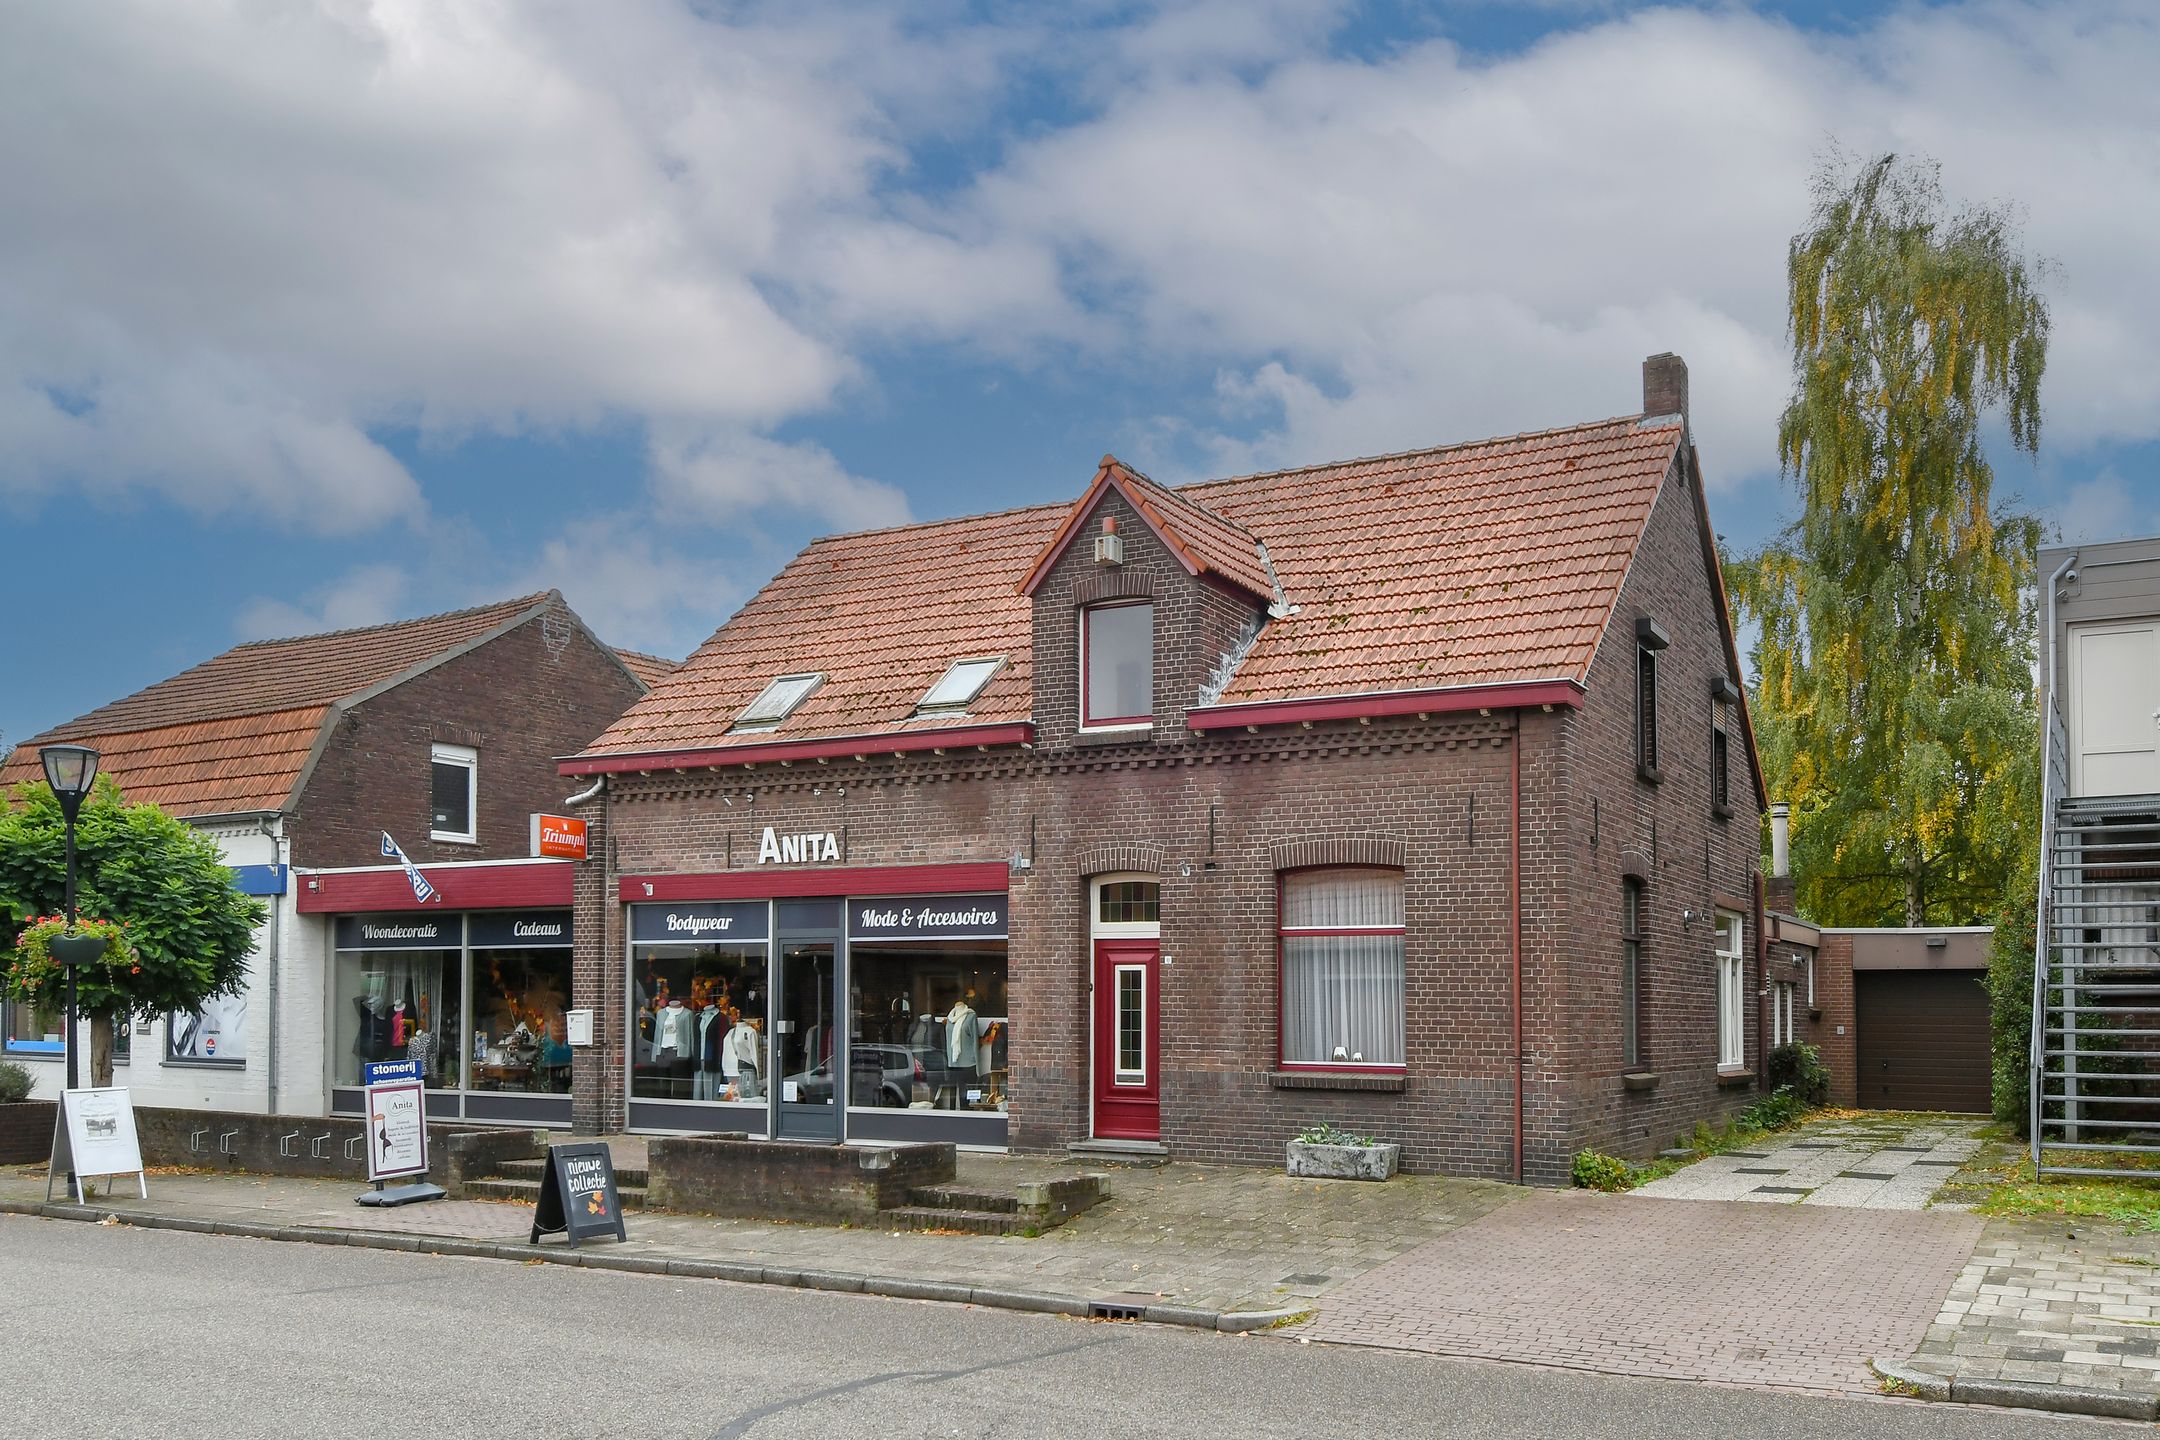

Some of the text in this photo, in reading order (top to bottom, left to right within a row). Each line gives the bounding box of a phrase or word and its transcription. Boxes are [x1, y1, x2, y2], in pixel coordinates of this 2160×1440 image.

[542, 827, 585, 848] Triumph
[758, 827, 840, 864] ANITA
[666, 913, 733, 935] Bodywear
[861, 907, 999, 928] Mode & Accessoires
[362, 923, 438, 939] Woondecoratie
[513, 920, 561, 937] Cadeaus
[372, 1061, 416, 1075] stomerij
[392, 1101, 413, 1110] Anita
[567, 1158, 602, 1175] nieuwe
[568, 1172, 607, 1193] collectie
